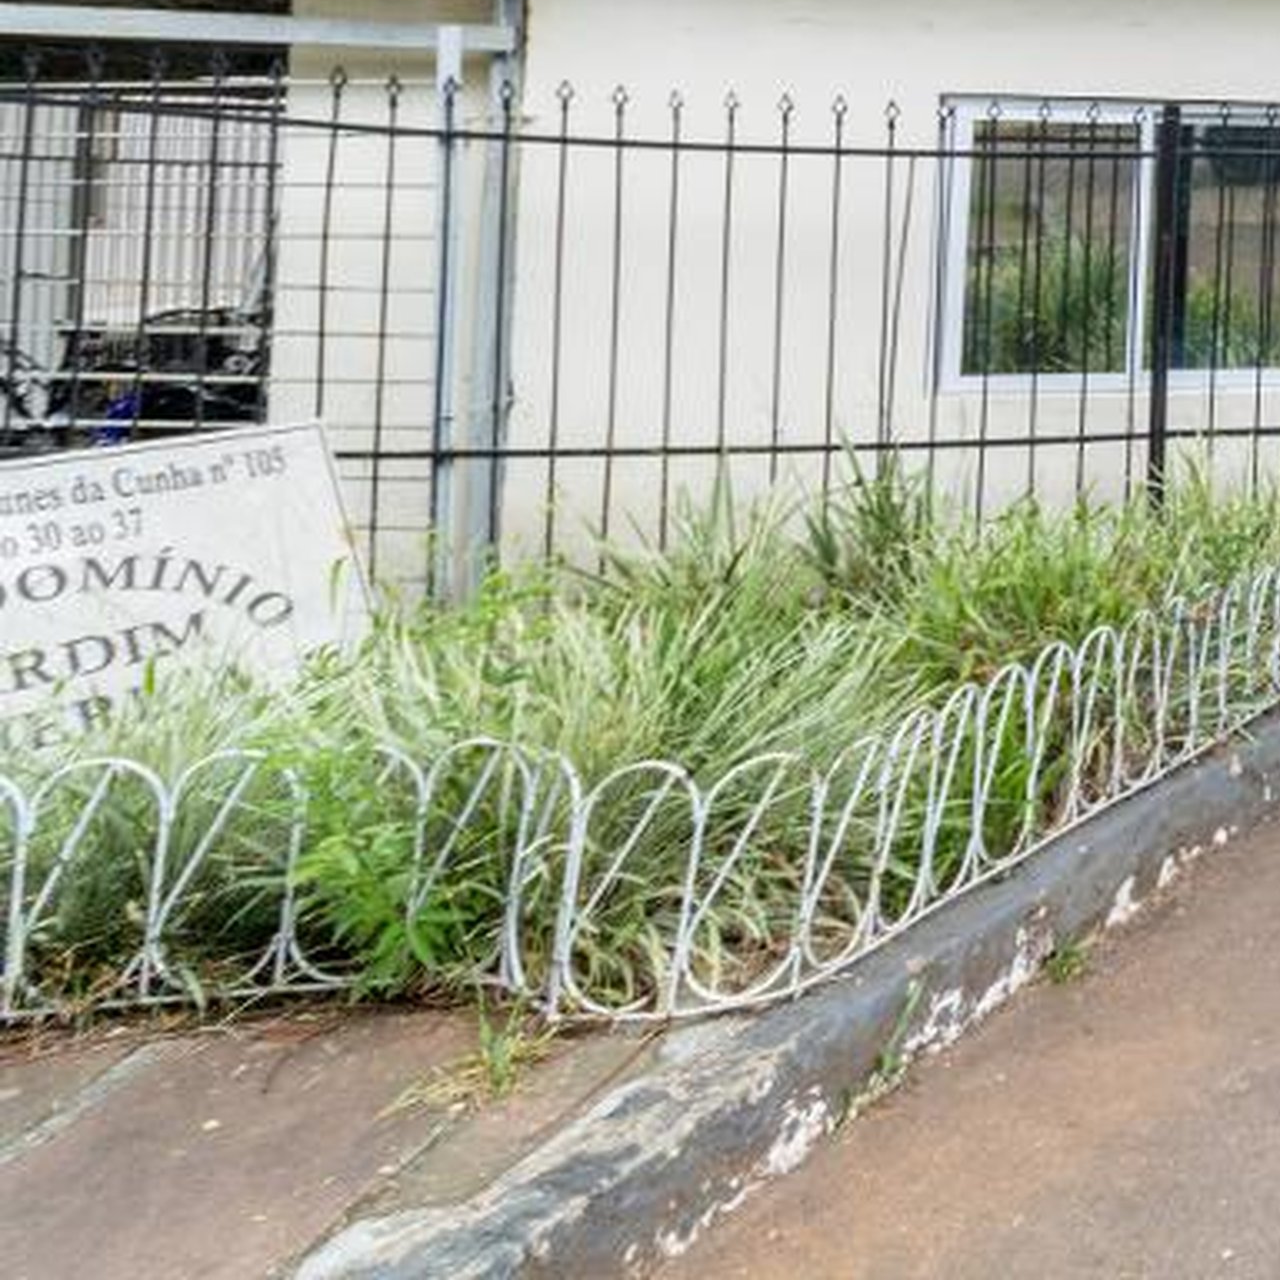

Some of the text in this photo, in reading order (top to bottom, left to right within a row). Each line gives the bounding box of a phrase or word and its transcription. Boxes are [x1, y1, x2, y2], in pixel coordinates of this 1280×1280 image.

[71, 475, 105, 505] da
[111, 462, 202, 498] Cunha
[244, 446, 288, 477] 105
[26, 522, 62, 554] 30
[69, 524, 105, 547] ao
[110, 507, 144, 540] 37
[0, 547, 294, 628] OMÍNIO
[0, 610, 204, 692] RDIM
